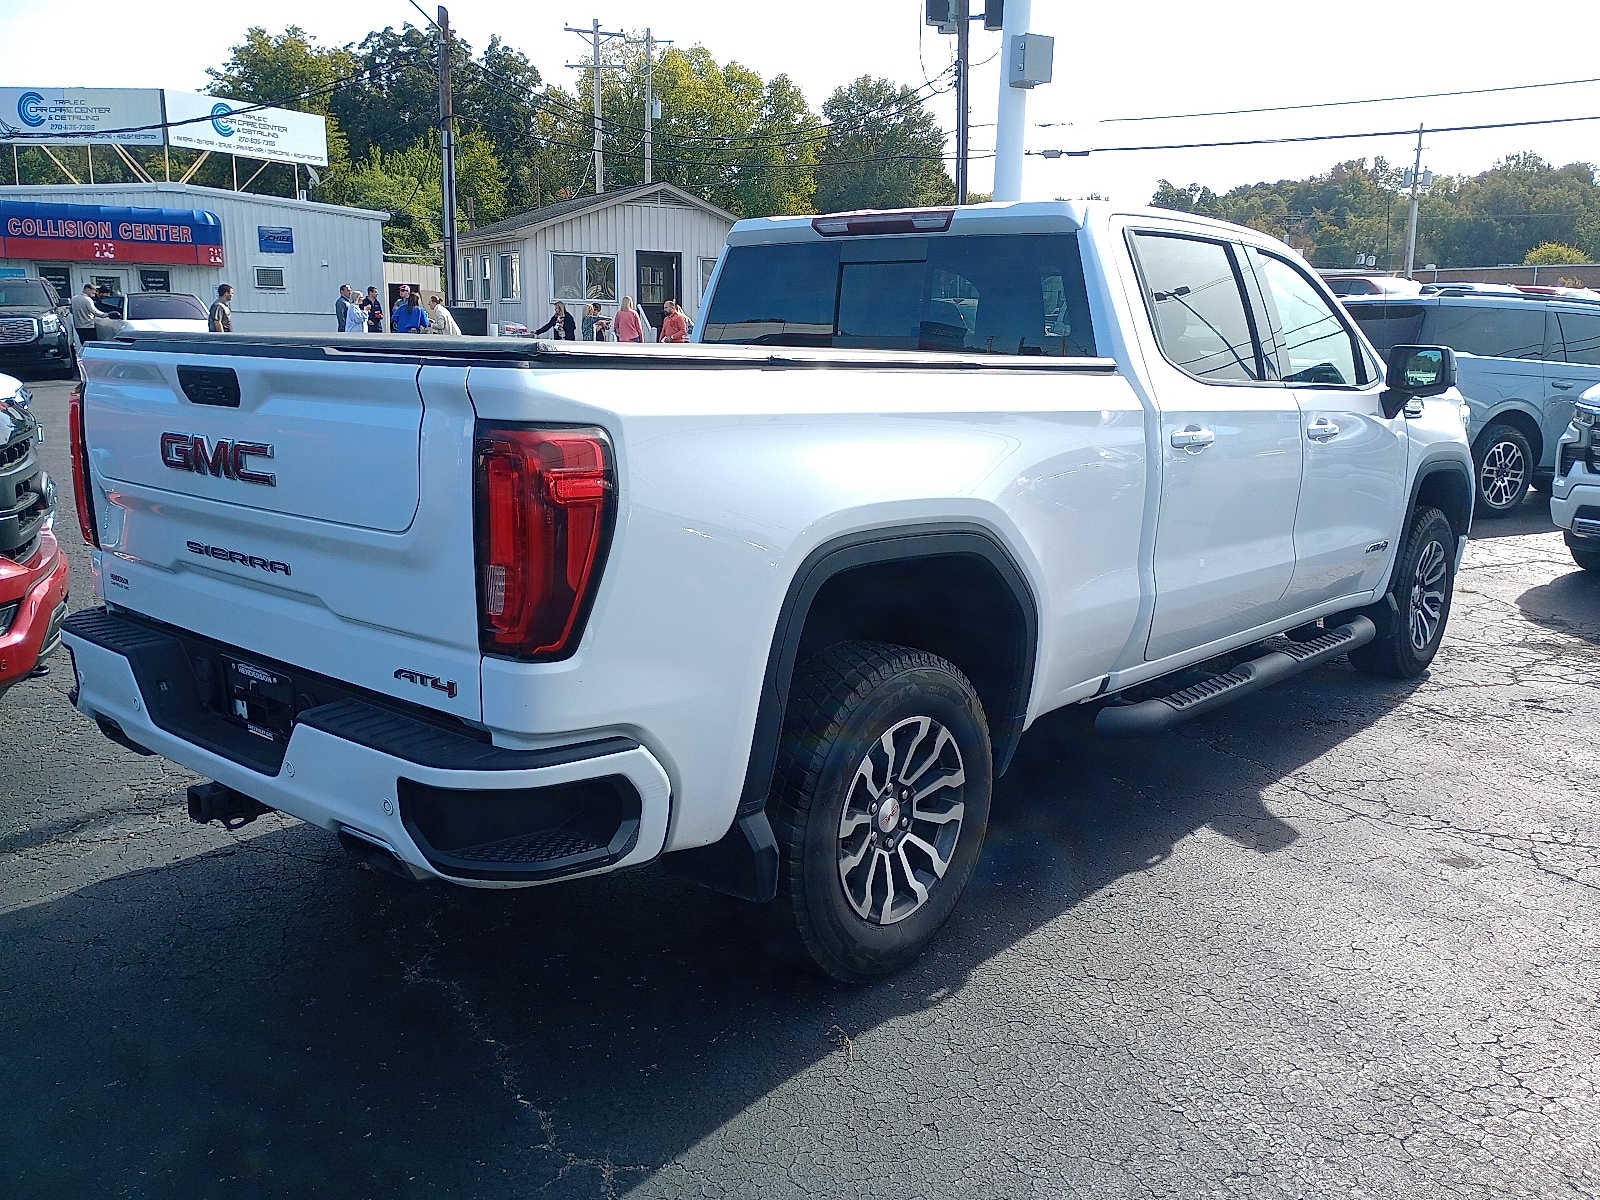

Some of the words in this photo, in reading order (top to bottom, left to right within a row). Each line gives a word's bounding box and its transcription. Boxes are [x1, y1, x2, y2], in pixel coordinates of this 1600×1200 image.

[49, 106, 73, 114] CARE
[74, 106, 111, 114] CENTER
[237, 119, 258, 129] CARE
[258, 122, 288, 132] CENTER
[7, 217, 112, 239] COLLISION
[118, 222, 193, 243] CENTER
[160, 431, 277, 487] GMC
[186, 540, 292, 576] SIERRA
[393, 667, 458, 699] AT4
